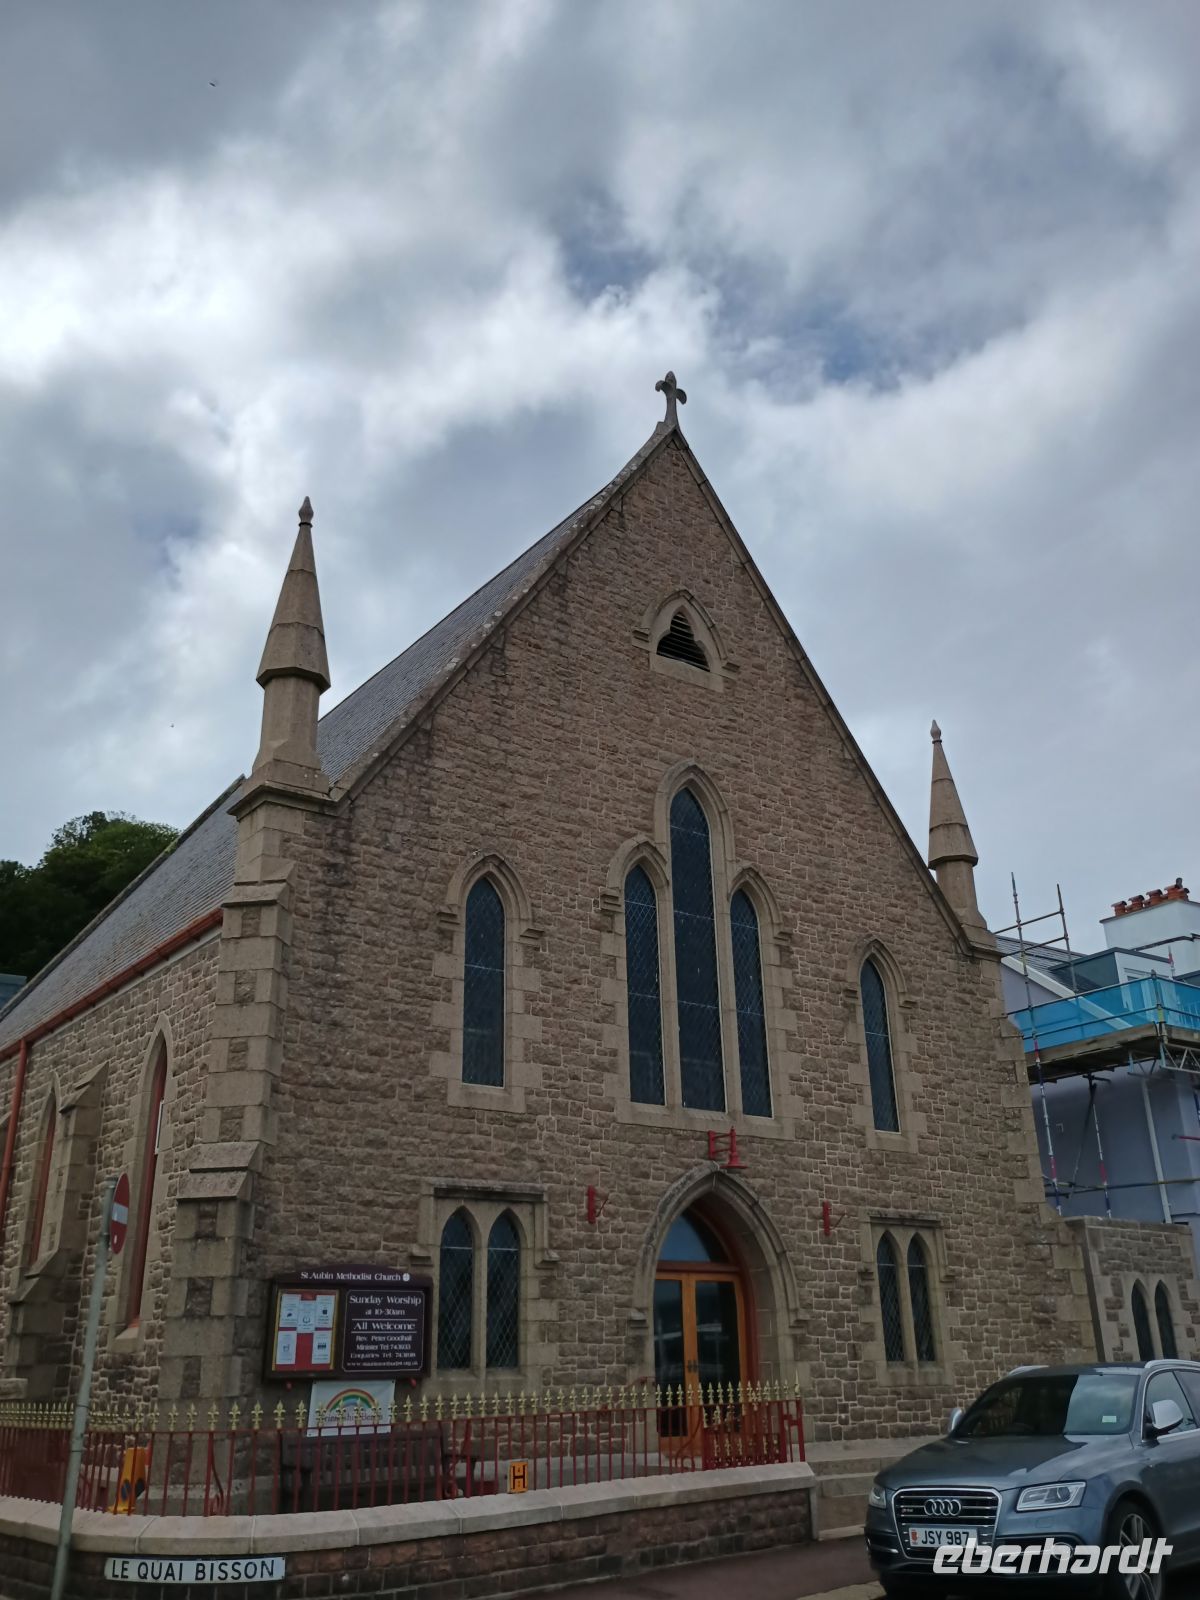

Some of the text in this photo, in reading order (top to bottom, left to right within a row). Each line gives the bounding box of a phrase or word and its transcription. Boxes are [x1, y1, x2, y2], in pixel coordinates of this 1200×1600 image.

[336, 1272, 372, 1281] Methodist
[374, 1273, 401, 1282] Church
[349, 1295, 422, 1307] Sunday Worship
[353, 1322, 416, 1331] All Welcome
[512, 1465, 526, 1490] H
[921, 1530, 970, 1546] JSY 987
[111, 1559, 275, 1581] LE QUAI BISSON
